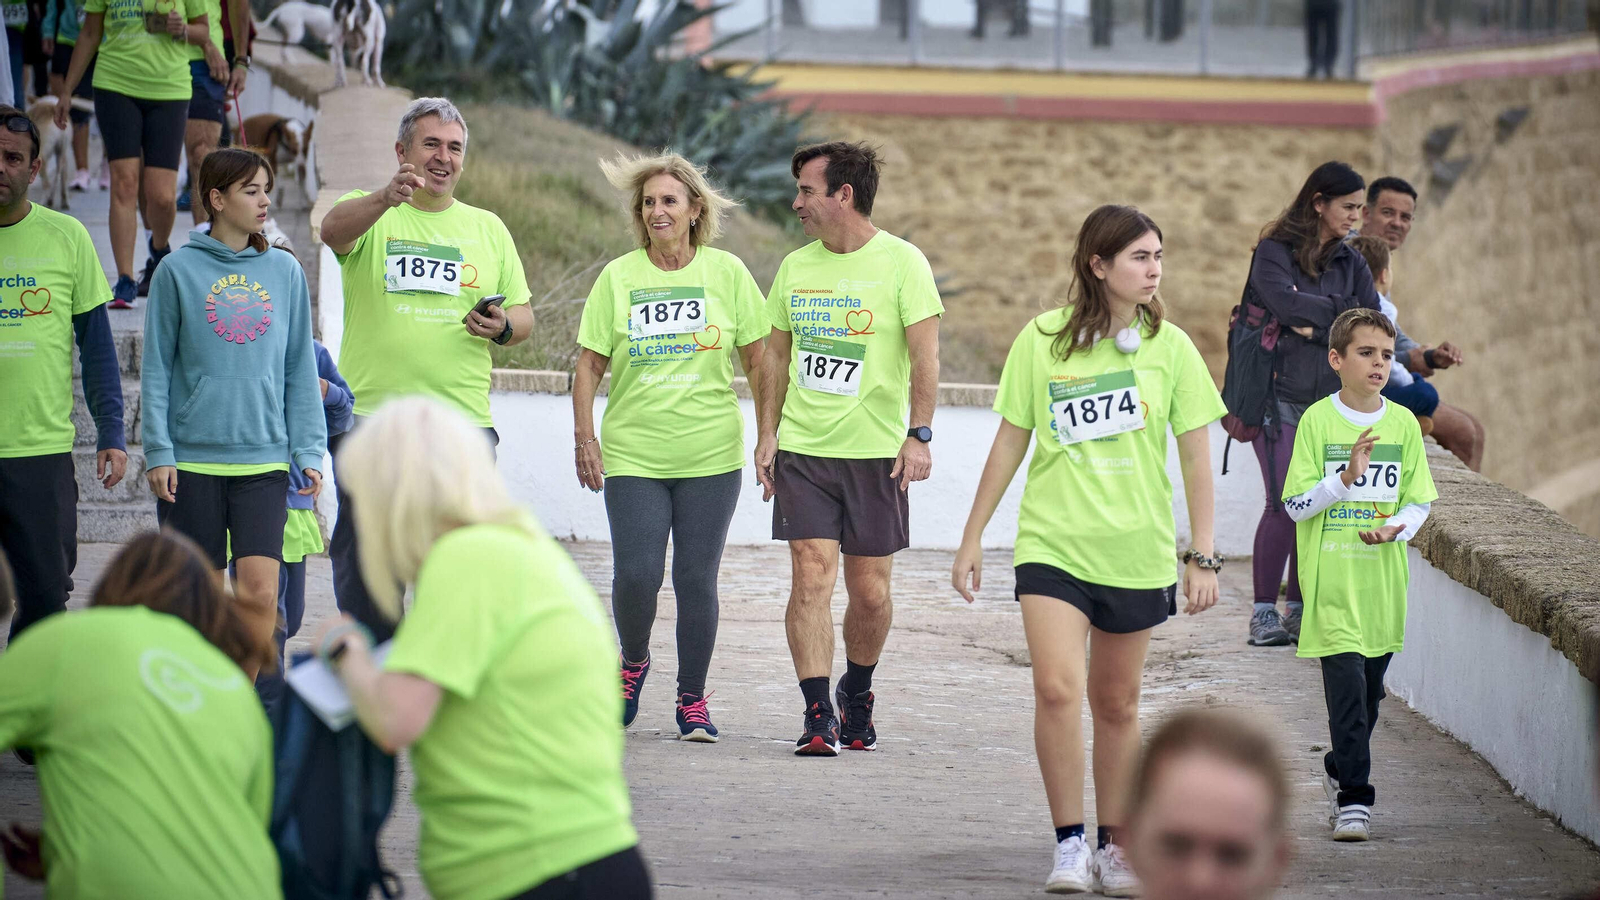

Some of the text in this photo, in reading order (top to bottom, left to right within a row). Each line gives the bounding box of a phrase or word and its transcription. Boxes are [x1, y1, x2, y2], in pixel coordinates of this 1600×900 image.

[396, 257, 457, 282] 1875
[791, 295, 861, 308] En marcha
[639, 300, 701, 325] 1873
[791, 309, 831, 322] contra
[802, 323, 850, 337] cáncer
[629, 342, 698, 357] el cáncer
[804, 354, 859, 382] 1877
[1063, 390, 1137, 427] 1874
